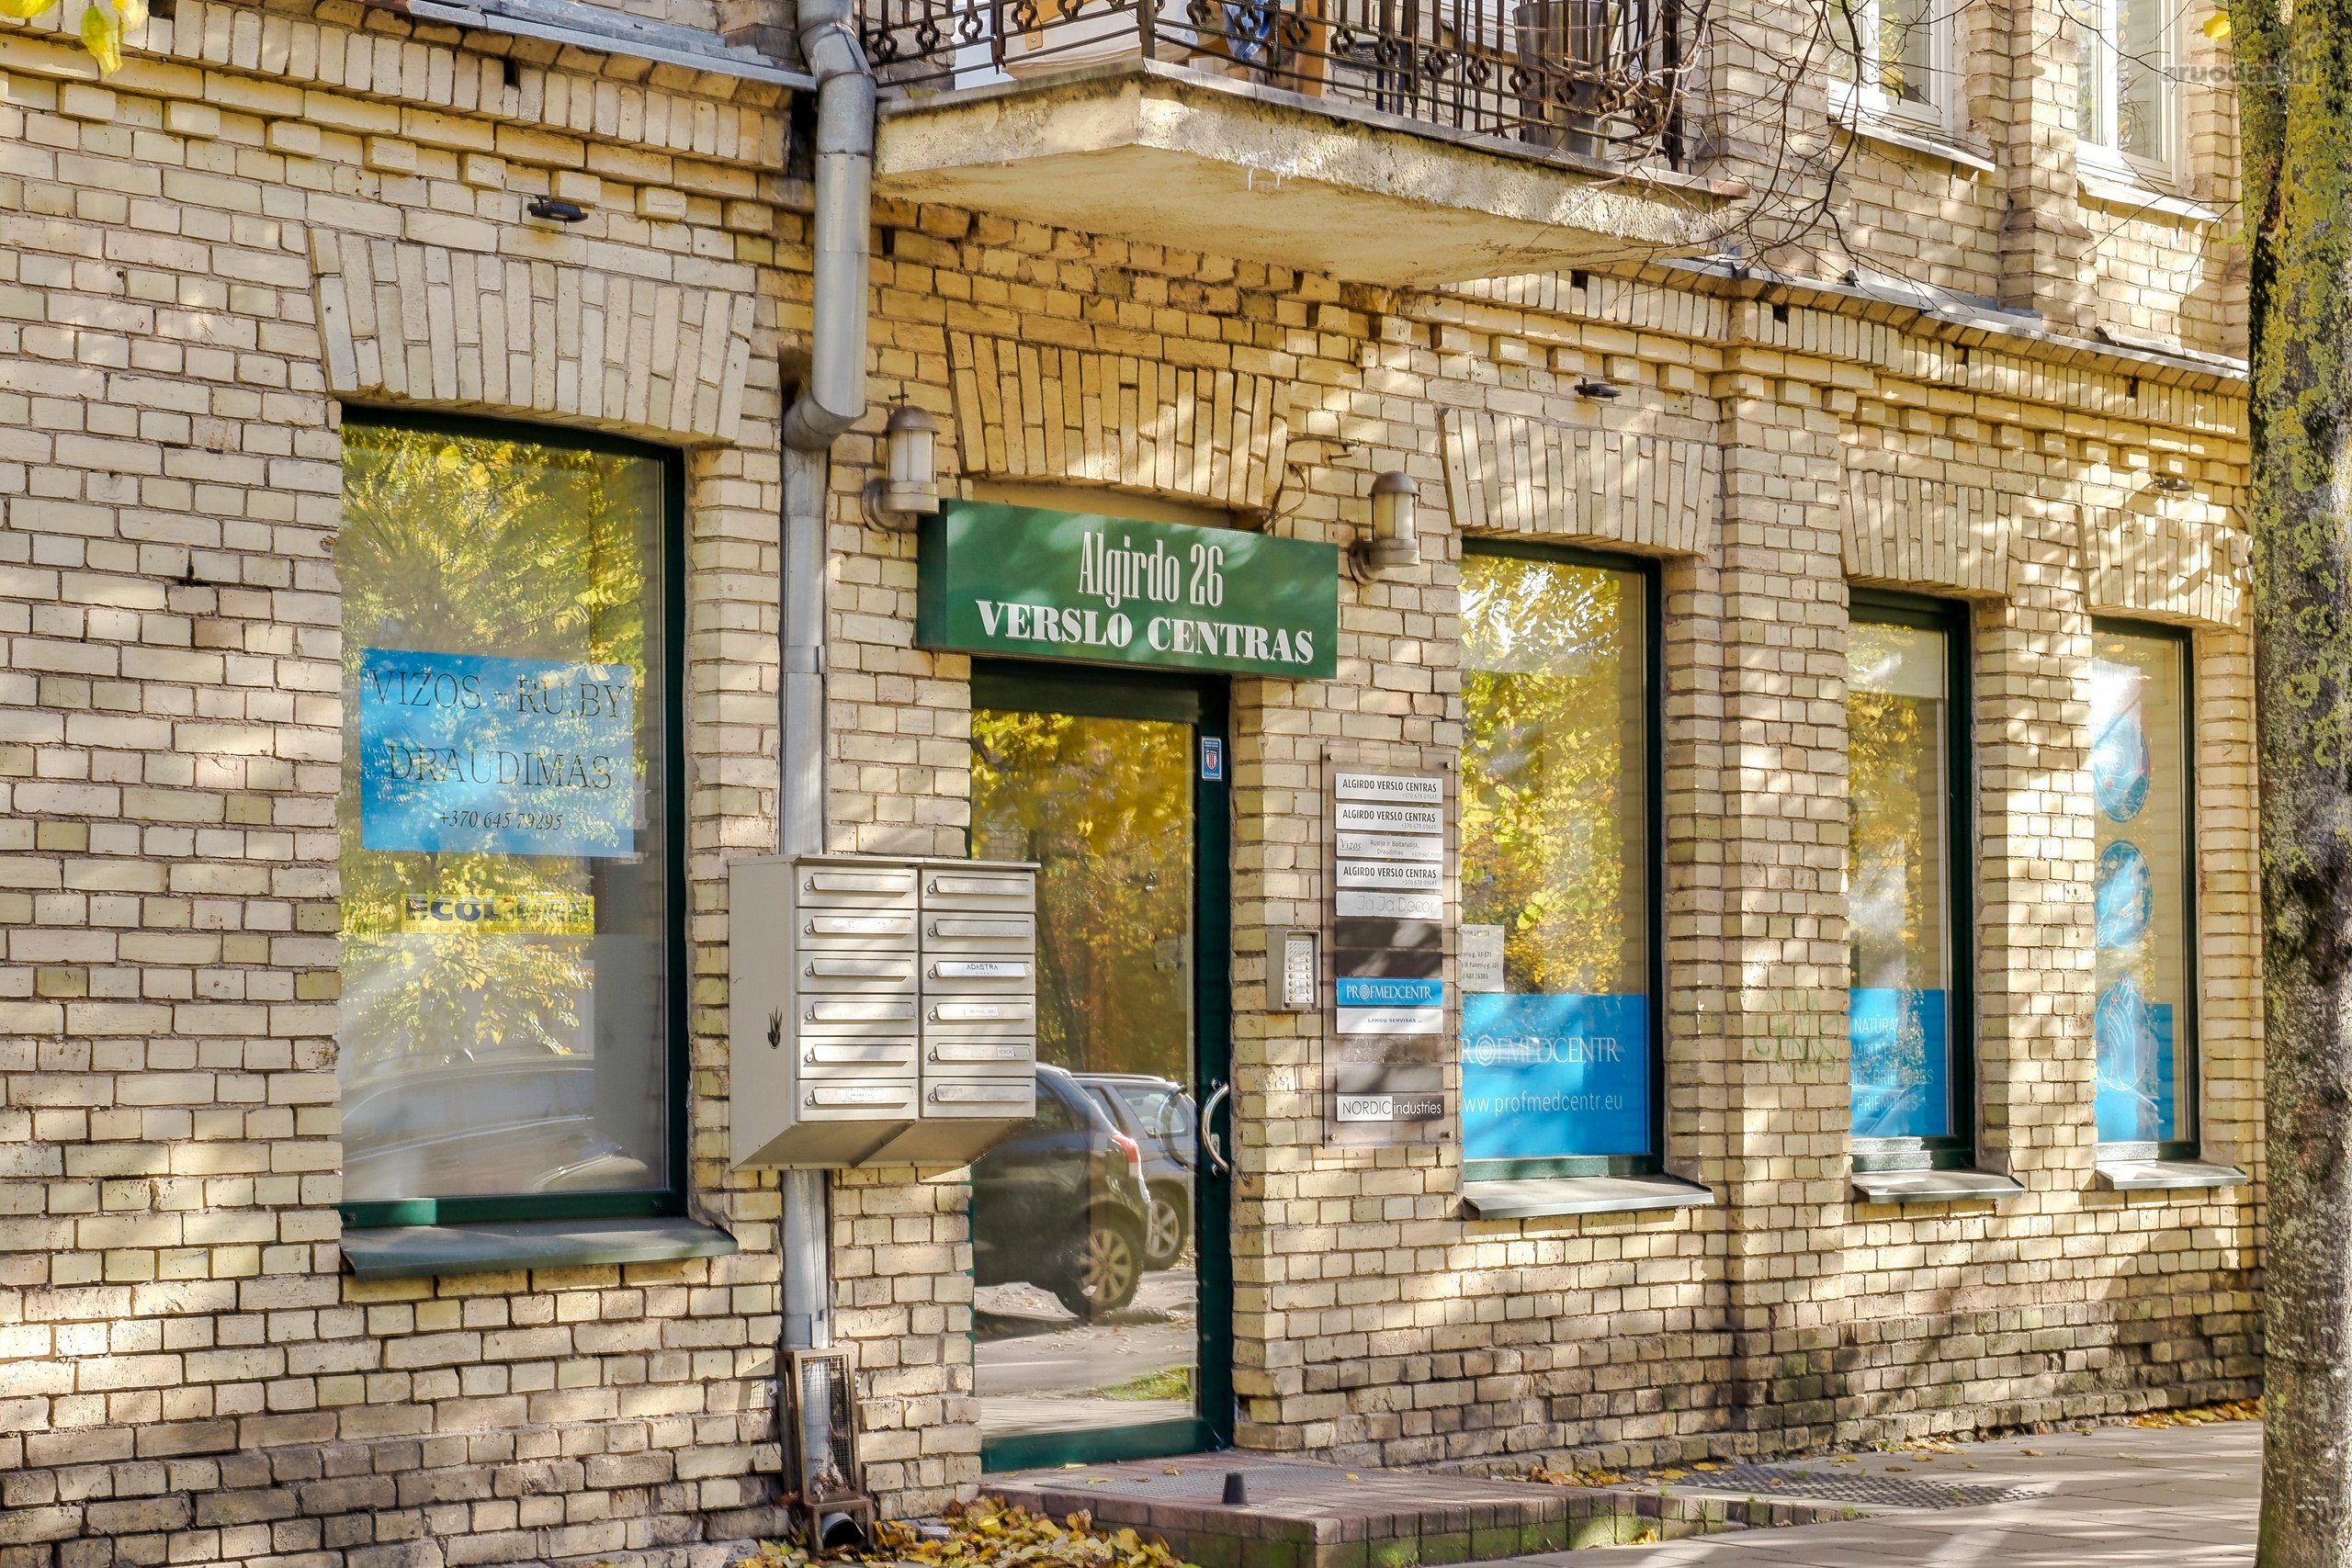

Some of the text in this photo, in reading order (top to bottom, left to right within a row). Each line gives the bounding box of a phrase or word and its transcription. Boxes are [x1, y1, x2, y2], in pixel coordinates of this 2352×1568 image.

[1078, 531, 1224, 608] Algirdo 26
[976, 600, 1314, 665] VERSLO CENTRAS
[369, 670, 481, 709] VIZOS
[388, 745, 613, 790] DRAUDIMAS
[1342, 779, 1437, 793] ALGIRDO VERSLO CENTRAS
[440, 810, 563, 830] +370 645 79295
[1342, 809, 1436, 823] ALGIRDO VERSLO CENTRAS
[1339, 839, 1362, 850] Vizos
[1343, 866, 1437, 879] ALGIRDO VERSLO CENTRAS
[405, 897, 590, 921] ECOL
[1358, 895, 1434, 912] Ja Ja Decor
[1342, 1100, 1442, 1115] NORDIC industries
